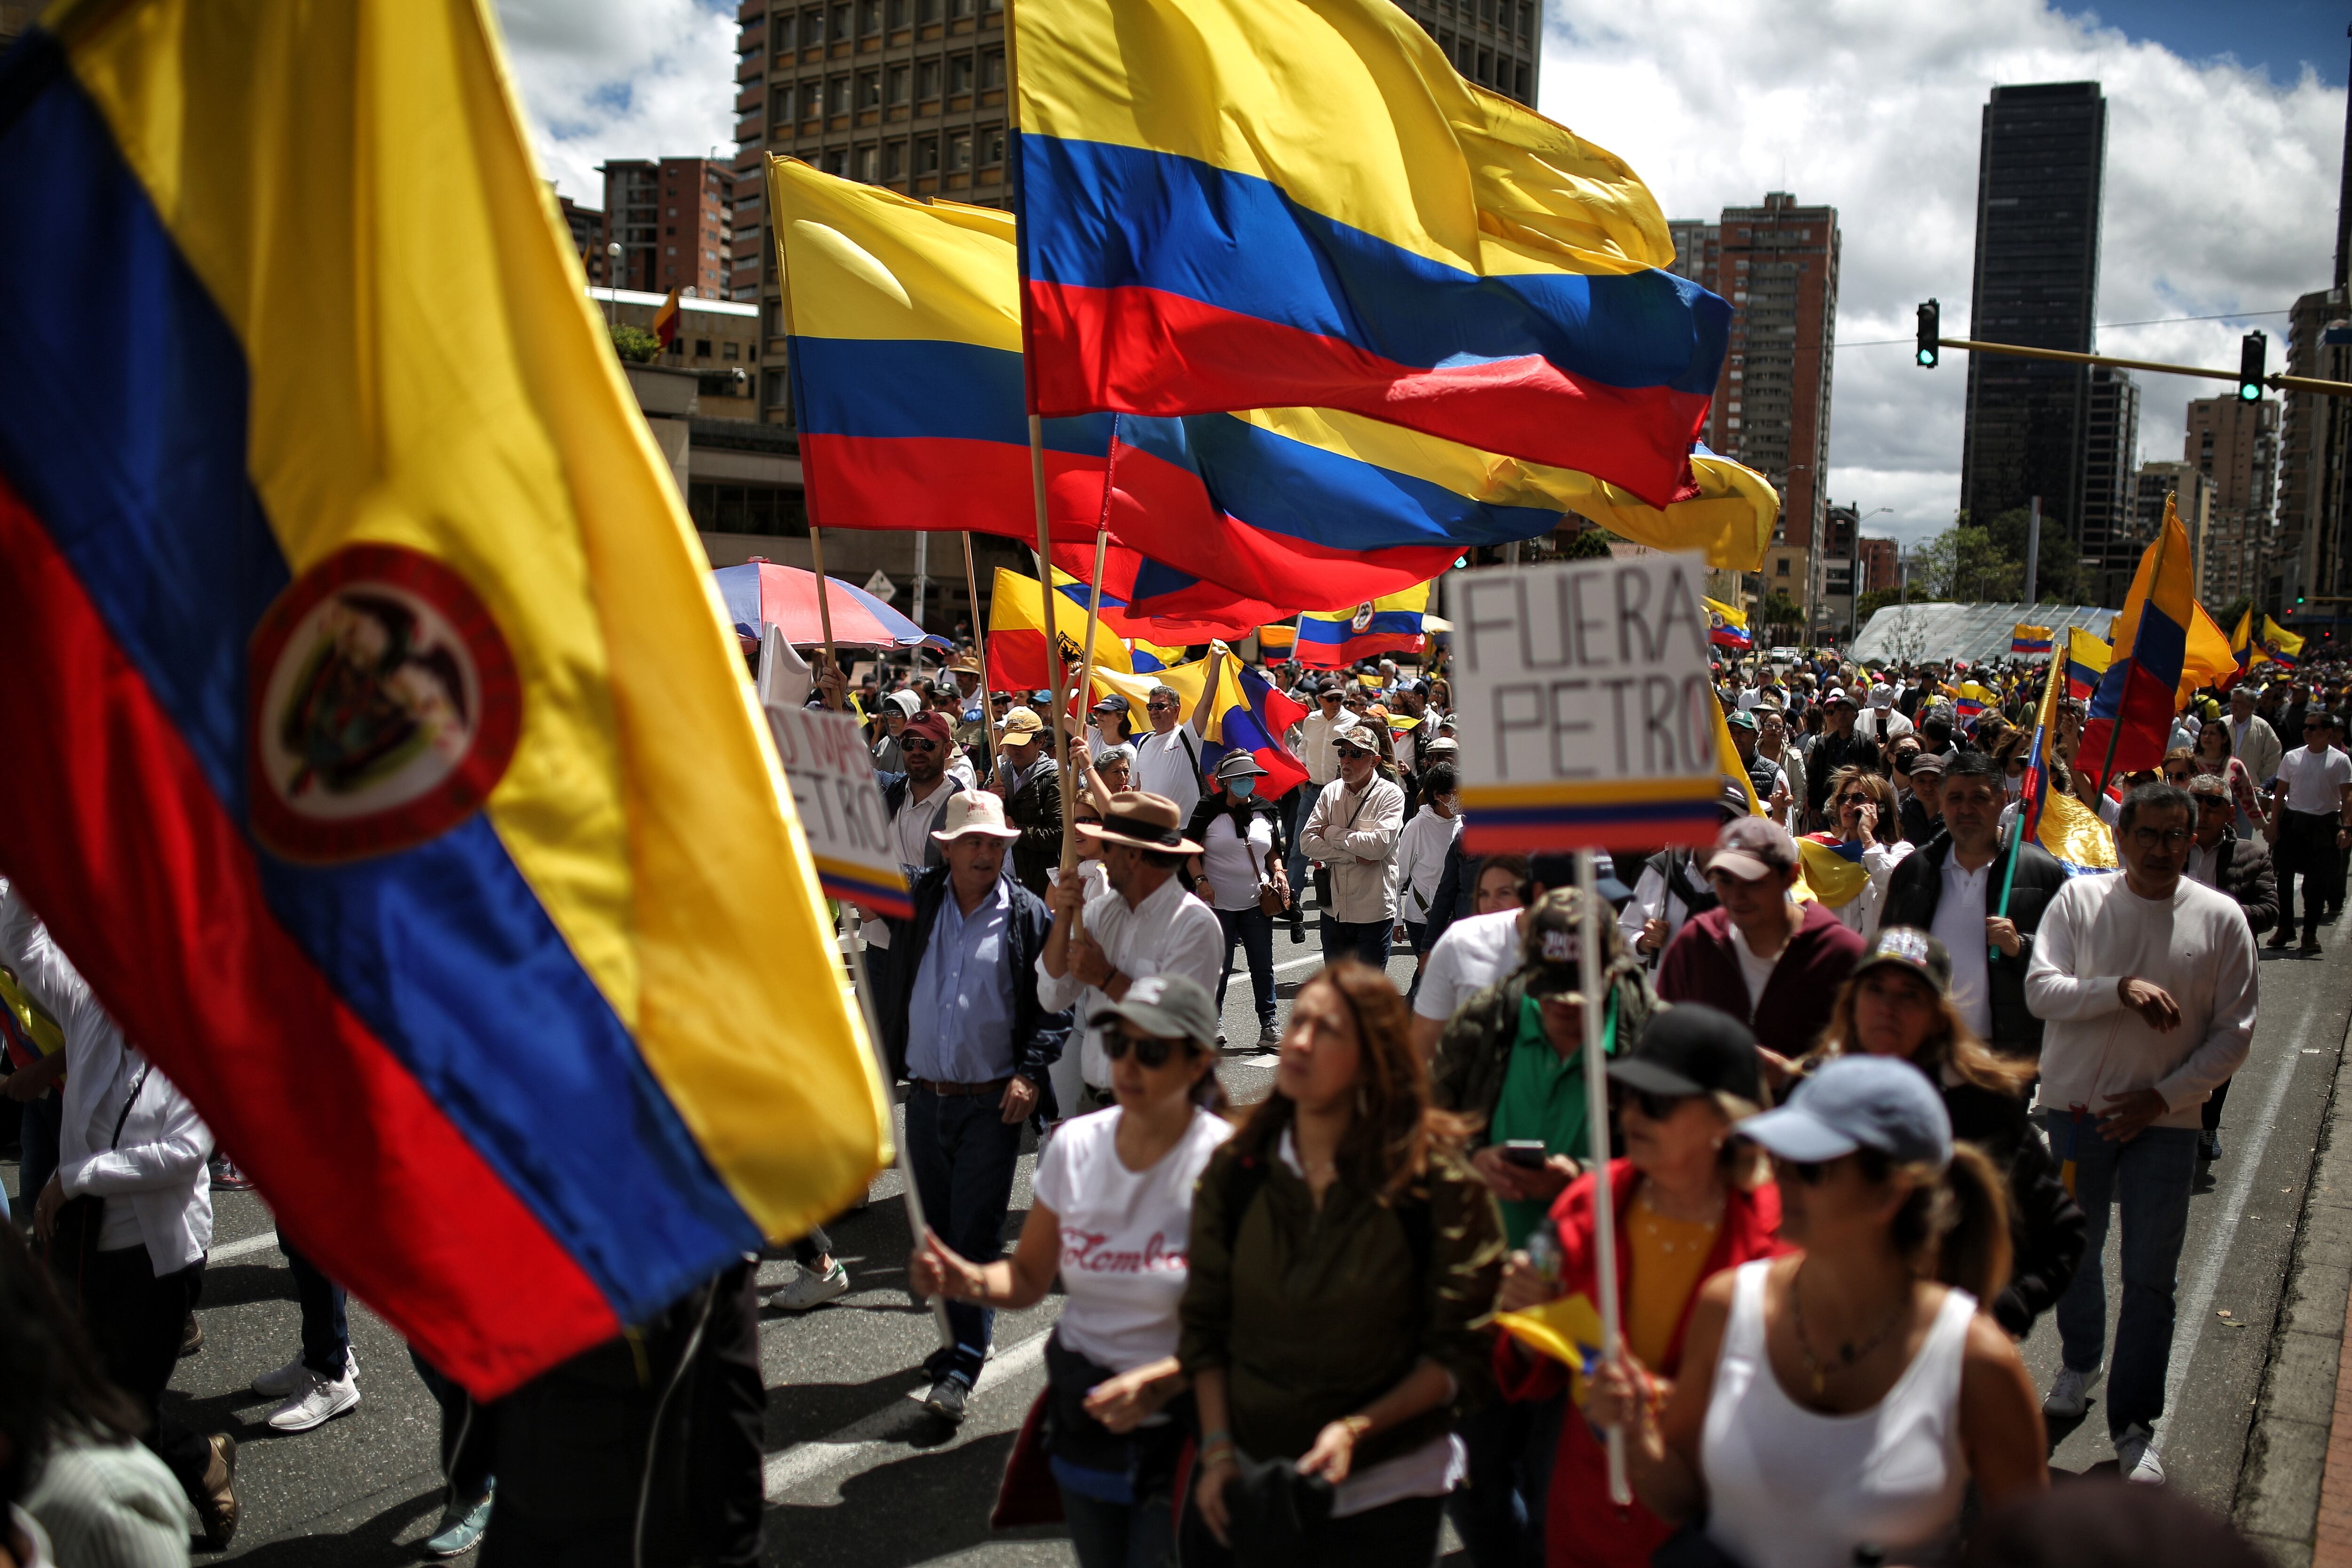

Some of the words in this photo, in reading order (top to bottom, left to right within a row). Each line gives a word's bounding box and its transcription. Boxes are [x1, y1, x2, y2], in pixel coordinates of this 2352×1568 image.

[1462, 564, 1708, 673] FUERA
[1492, 674, 1715, 780] PETRO
[786, 766, 892, 855] TRO
[967, 803, 986, 812] 北京
